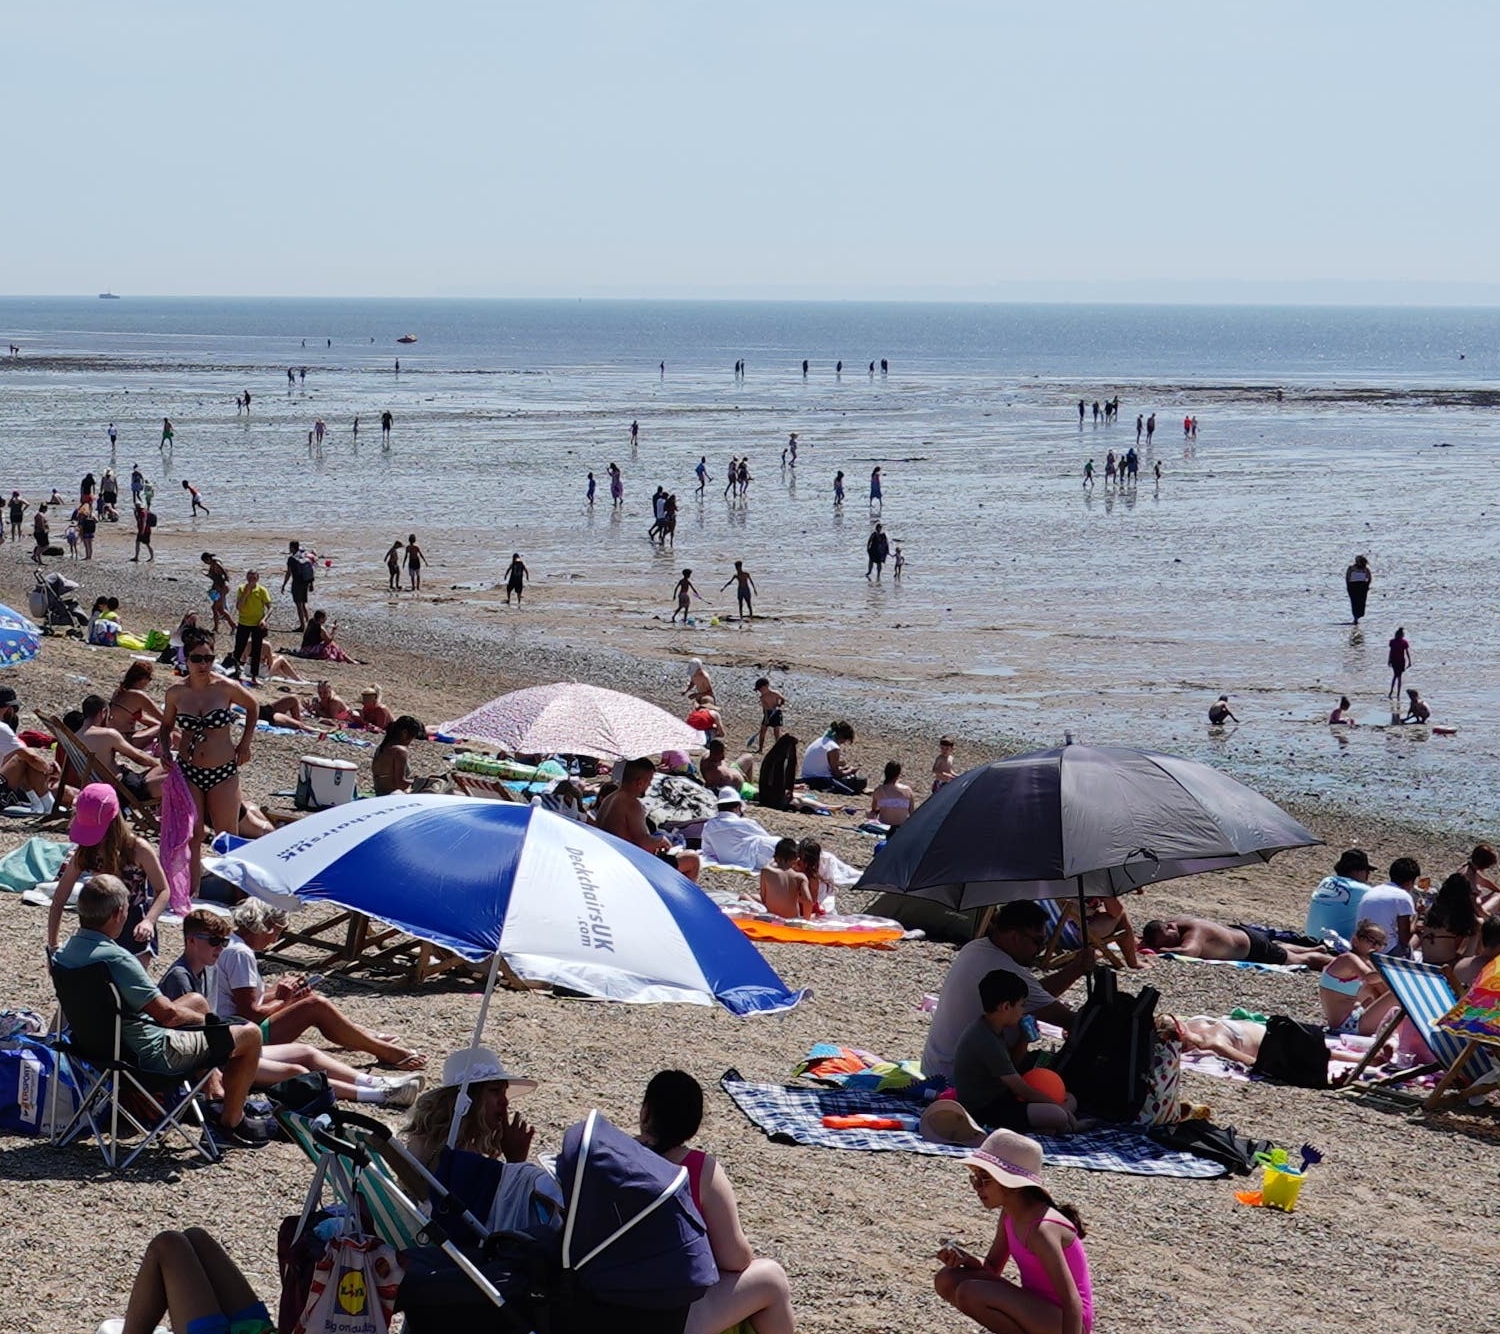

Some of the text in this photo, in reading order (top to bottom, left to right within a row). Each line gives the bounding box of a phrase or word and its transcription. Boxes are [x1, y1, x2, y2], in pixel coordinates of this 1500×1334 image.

[276, 837, 309, 857] .com
[280, 801, 424, 862] DeckchairsUK
[564, 845, 615, 953] DeckchairsUK
[577, 916, 591, 947] .com
[339, 1322, 350, 1332] on
